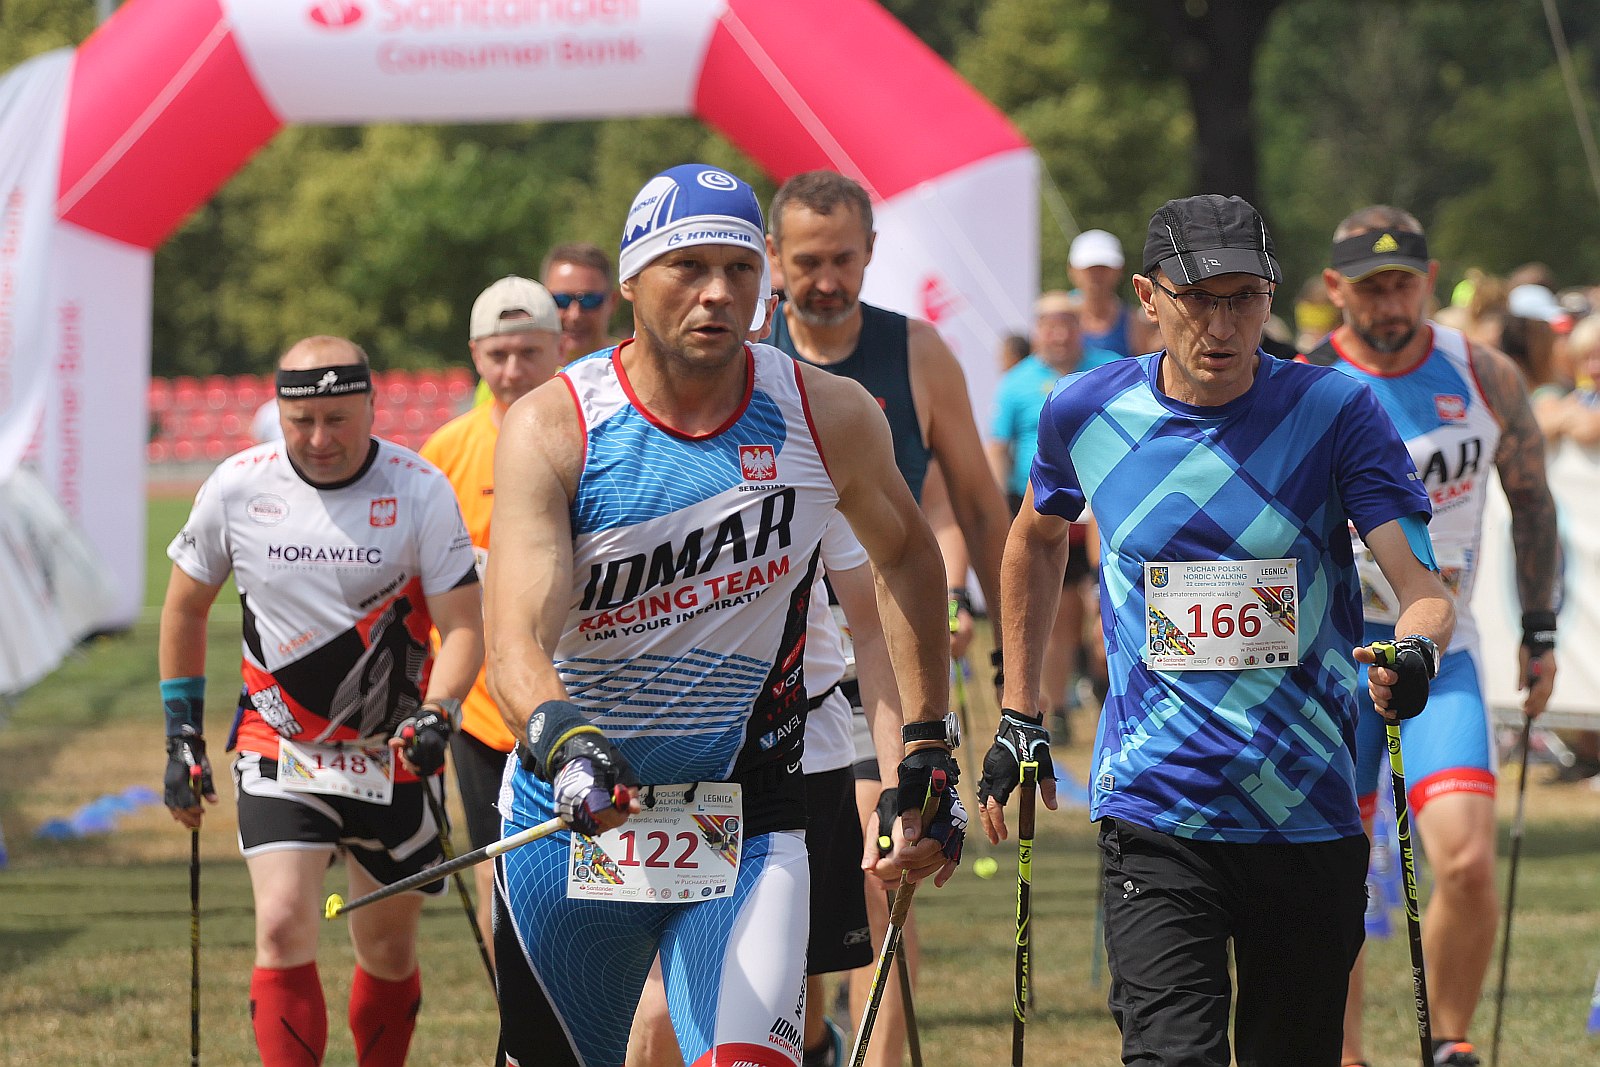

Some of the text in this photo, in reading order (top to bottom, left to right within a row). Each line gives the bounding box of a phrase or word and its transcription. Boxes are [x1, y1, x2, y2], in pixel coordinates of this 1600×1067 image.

[738, 483, 786, 492] SEBASTIAN
[268, 544, 382, 564] MORAWIEC
[579, 487, 796, 611] IDMAR
[1261, 567, 1289, 575] LEGNICA
[578, 555, 790, 633] RACING TEAM
[1216, 590, 1242, 598] walking?
[593, 628, 617, 641] AM
[621, 617, 672, 637] YOUR
[1187, 603, 1262, 638] 166
[311, 753, 367, 774] 148
[703, 793, 733, 803] LEGNICA
[654, 816, 681, 825] walking?
[617, 830, 699, 869] 122
[768, 1034, 793, 1053] RACING
